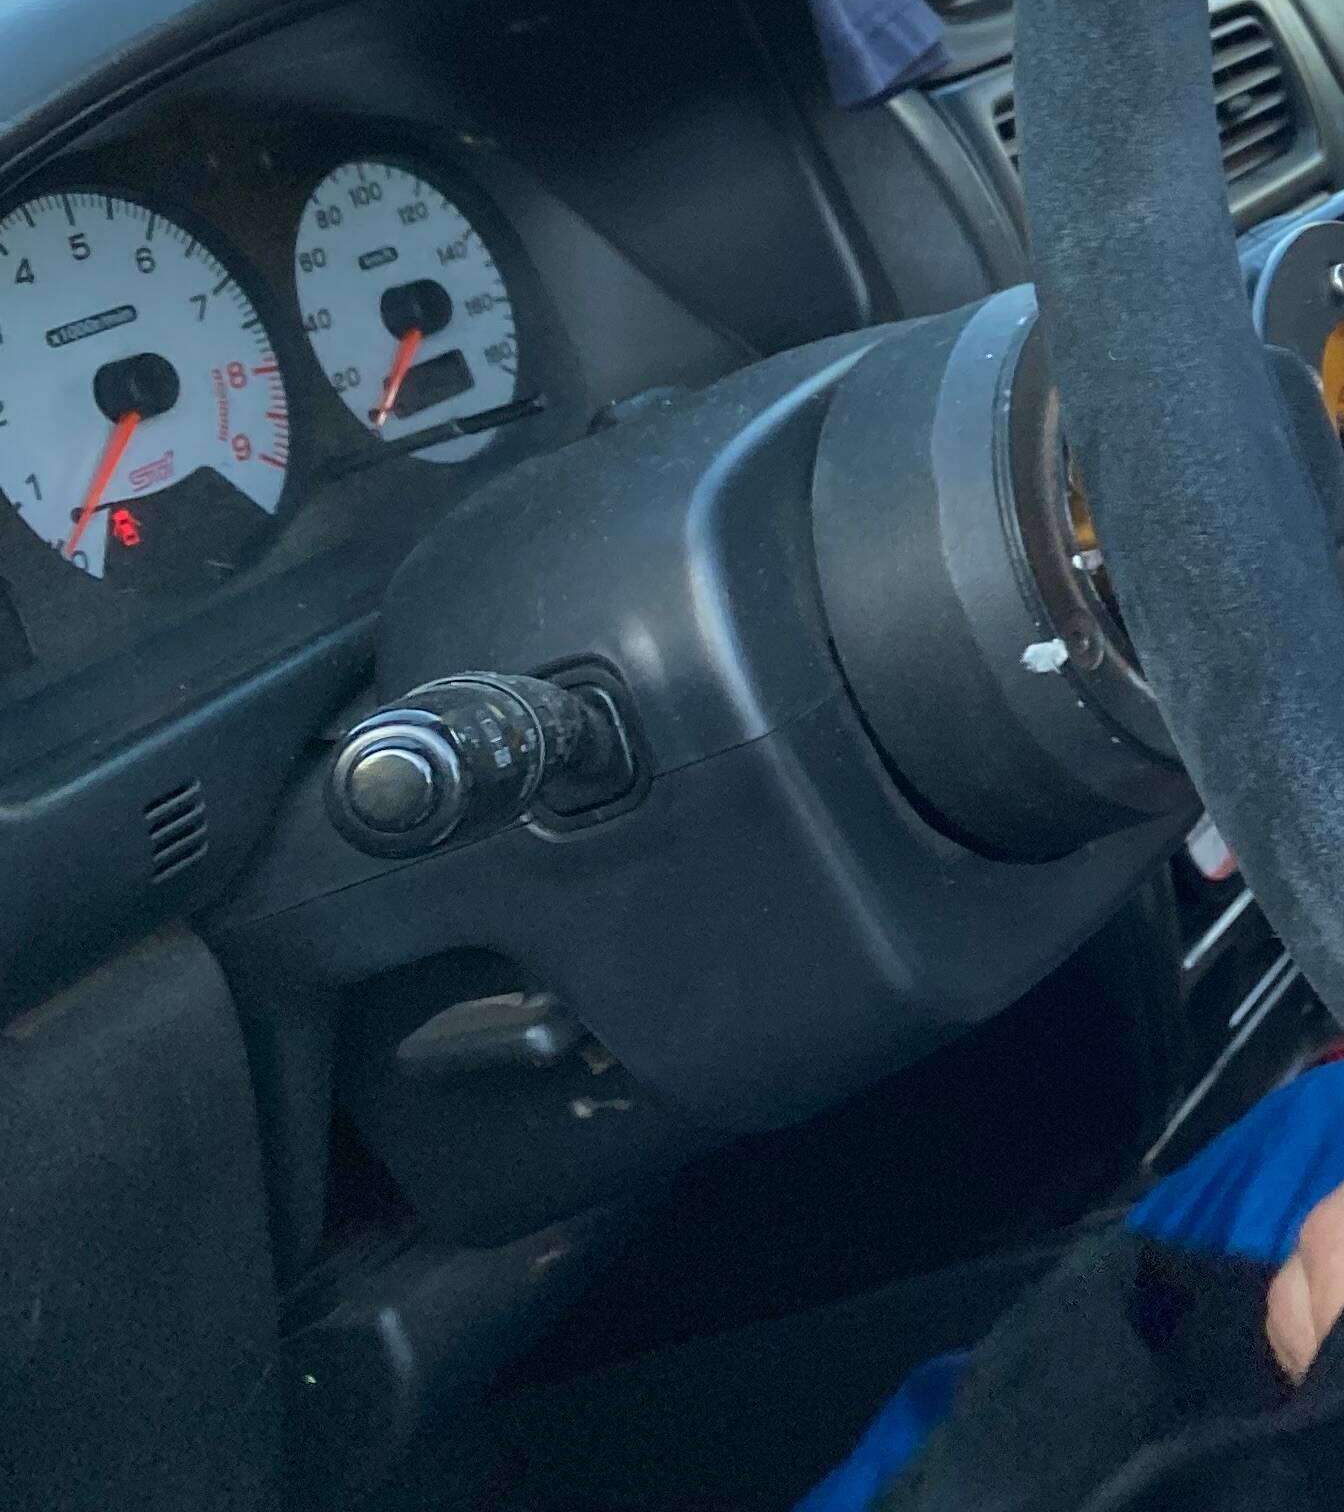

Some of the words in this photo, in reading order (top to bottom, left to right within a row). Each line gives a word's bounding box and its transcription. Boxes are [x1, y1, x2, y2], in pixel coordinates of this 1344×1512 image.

[350, 182, 382, 208] 100
[316, 205, 342, 229] 80
[68, 232, 91, 261] 5
[135, 246, 156, 274] 6
[14, 257, 35, 284] 4
[189, 293, 207, 322] 7
[227, 361, 247, 389] 8
[232, 433, 252, 461] 9
[25, 473, 42, 501] 1
